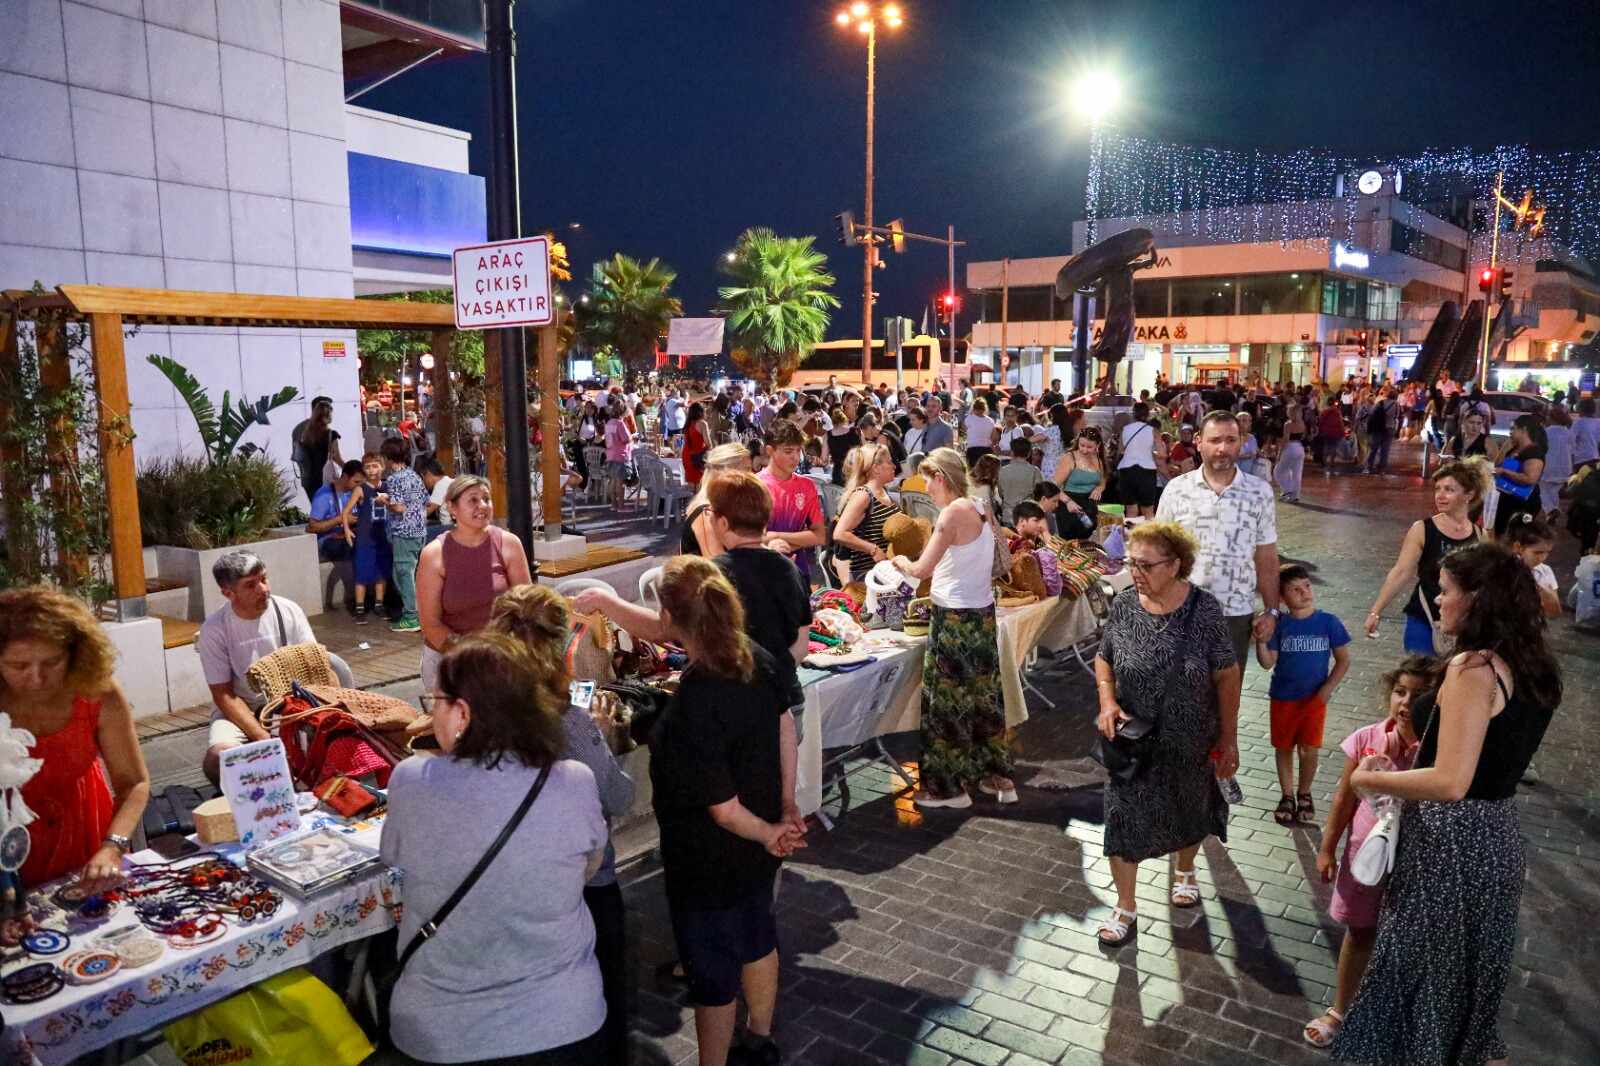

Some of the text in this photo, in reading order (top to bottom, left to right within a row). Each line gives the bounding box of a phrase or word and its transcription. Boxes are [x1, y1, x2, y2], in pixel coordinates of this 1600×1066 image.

[478, 252, 523, 270] ARAÇ
[475, 274, 528, 295] ÇIKIŞI
[461, 296, 546, 316] YASAKTIR
